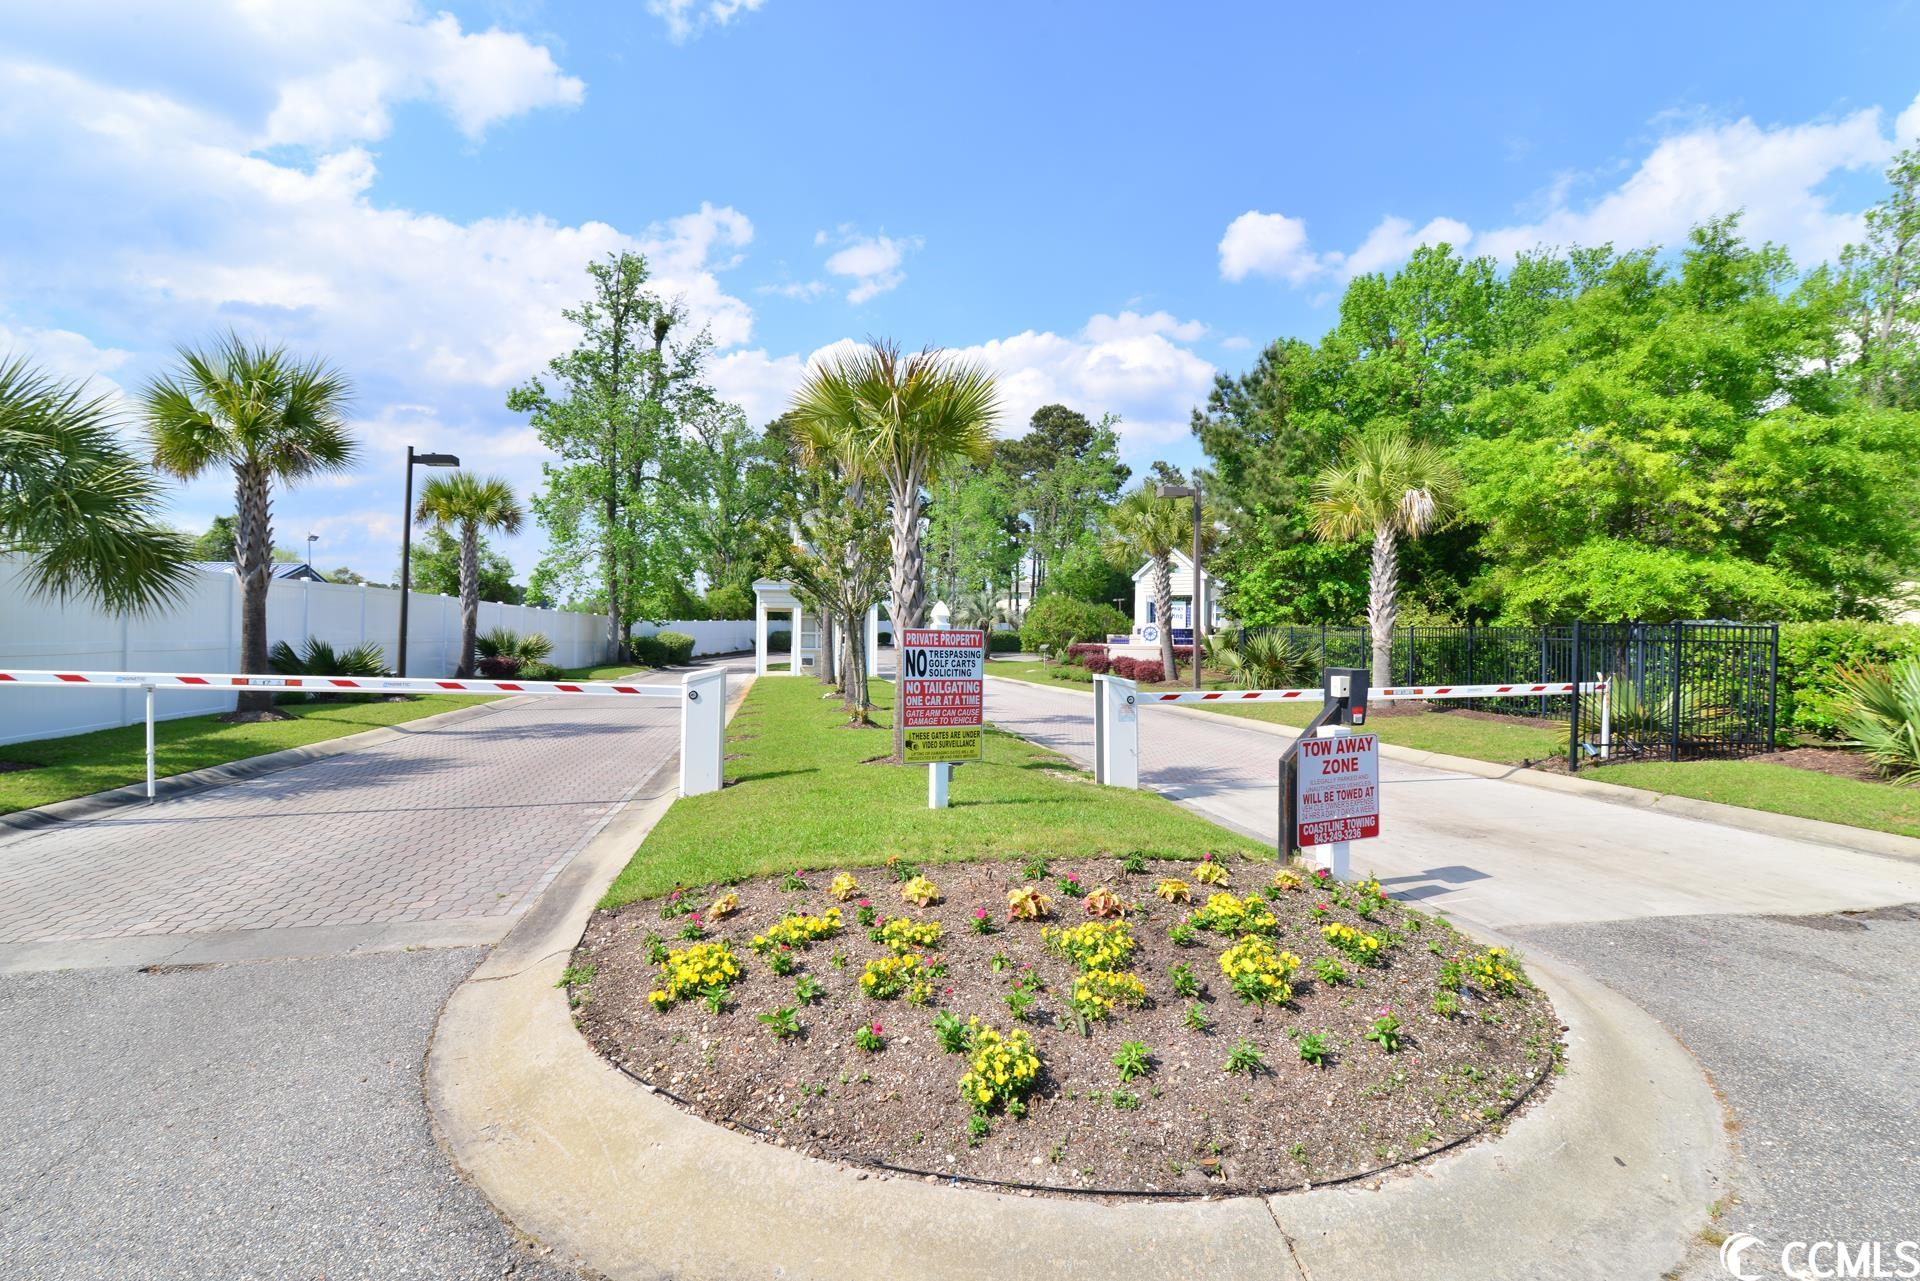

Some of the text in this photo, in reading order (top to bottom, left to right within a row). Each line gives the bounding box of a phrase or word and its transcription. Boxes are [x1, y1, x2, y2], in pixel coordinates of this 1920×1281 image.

[906, 633, 980, 646] PRIVATE PROPERTY
[929, 650, 981, 659] TRESPASSING
[905, 649, 928, 678] NO
[929, 660, 976, 668] GOLF CARTS
[929, 669, 972, 677] SOLICITING
[906, 681, 980, 694] NO TAILGATING
[906, 695, 980, 706] ONE CAR AT A TIME
[906, 708, 980, 717] GATE ARM CAN CAUSE
[908, 717, 938, 725] DAMAGE
[950, 716, 977, 724] VEHICLE
[912, 730, 980, 740] THESE GATES ARE UNDER
[922, 739, 976, 749] VIDEO SURVEILLANCE
[1303, 737, 1373, 757] TOW AWAY
[1322, 757, 1359, 774] ZONE
[1303, 787, 1374, 804] WILL BE TOWED AT
[1303, 816, 1376, 835] COASTLINE TOWING
[1314, 829, 1361, 844] 843-249-3236
